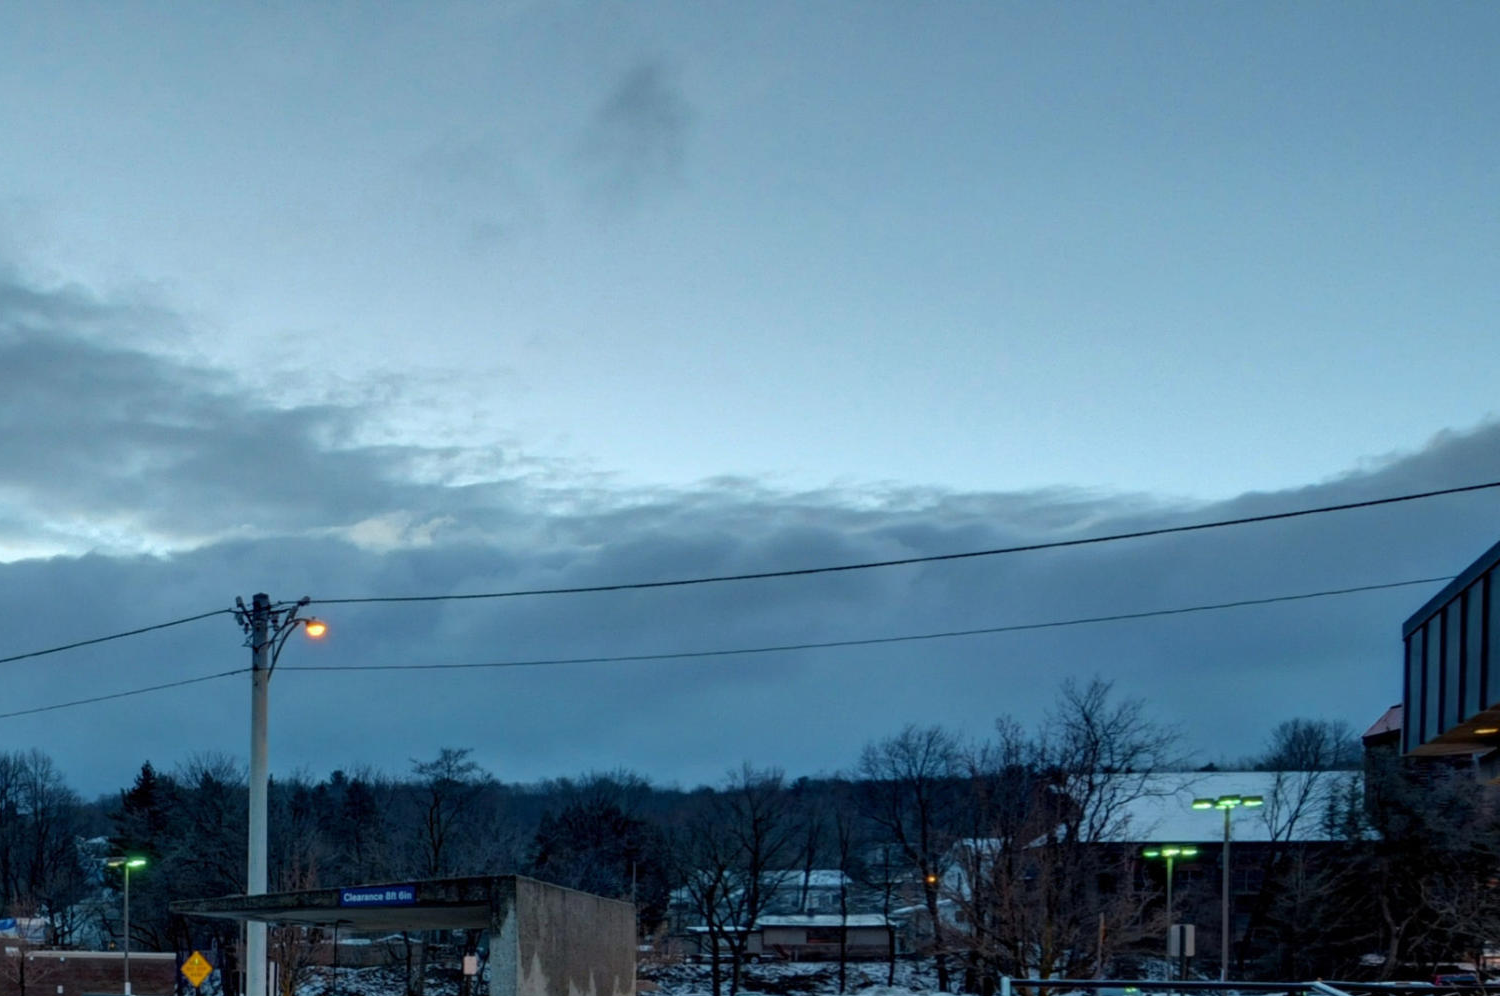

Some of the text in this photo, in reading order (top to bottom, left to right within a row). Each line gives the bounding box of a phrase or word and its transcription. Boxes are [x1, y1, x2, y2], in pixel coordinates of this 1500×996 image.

[343, 890, 412, 902] Clearance 8ft 6in
